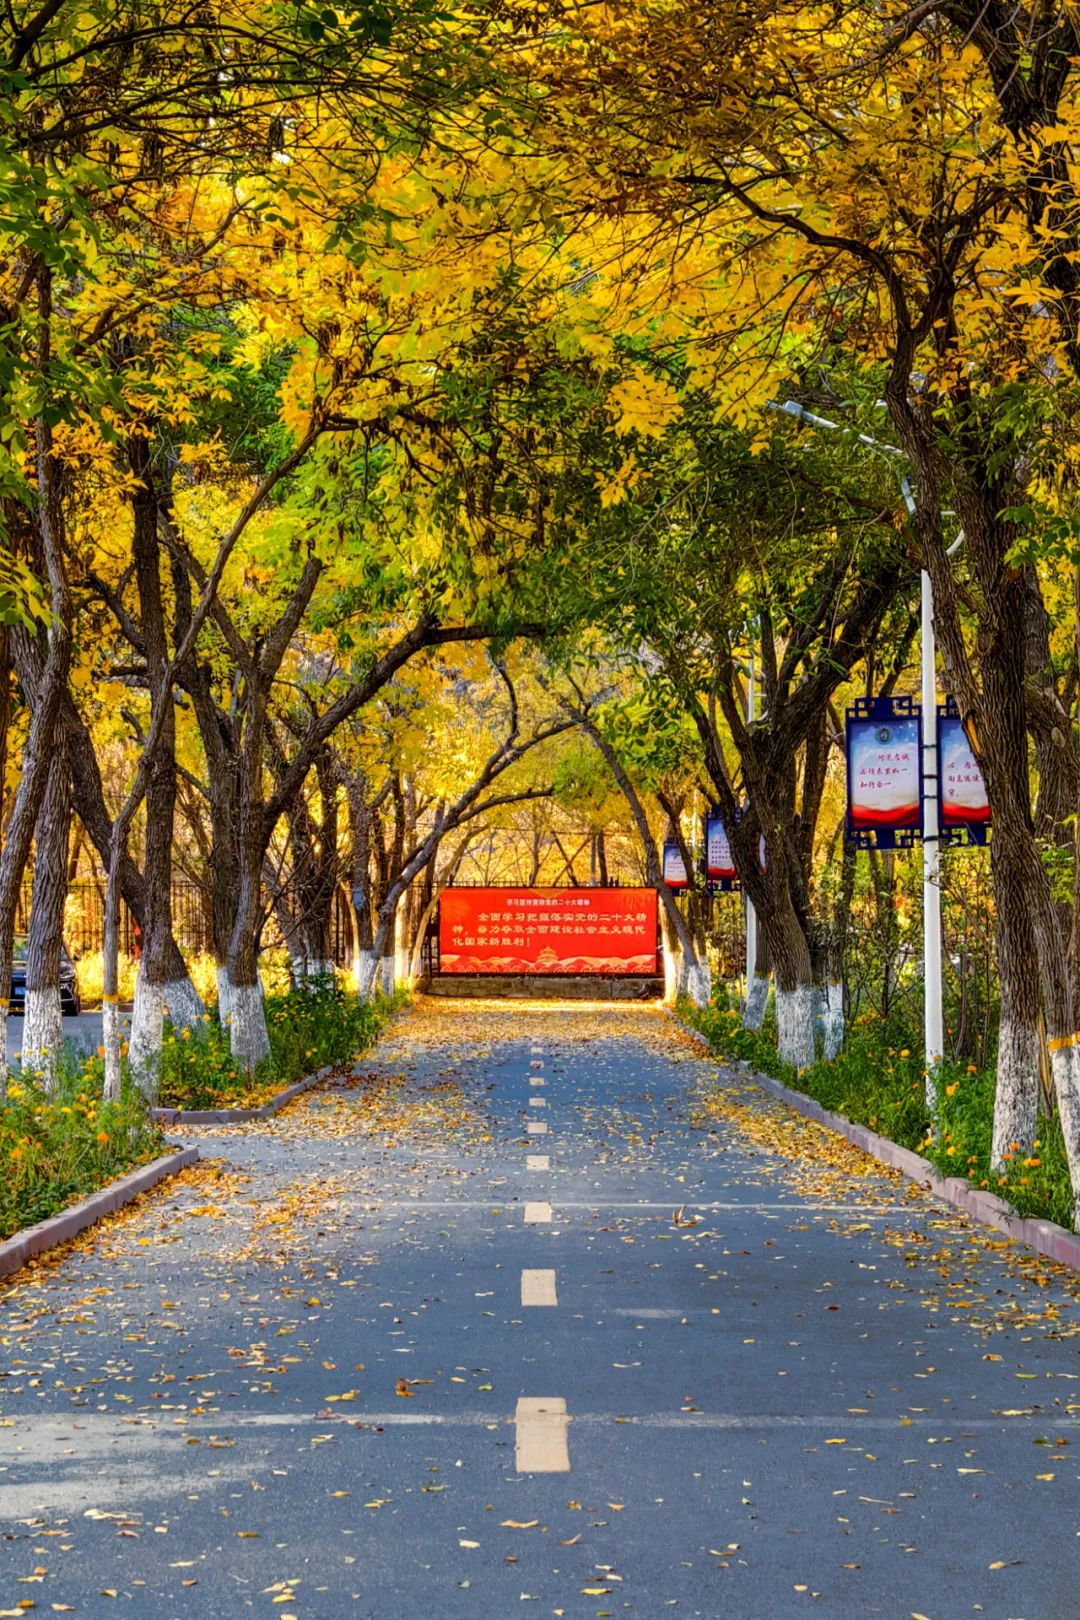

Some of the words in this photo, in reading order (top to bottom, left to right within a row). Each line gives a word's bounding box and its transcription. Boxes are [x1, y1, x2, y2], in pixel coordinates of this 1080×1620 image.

[477, 912, 647, 922] 全面学习把握落实党的二十大精
